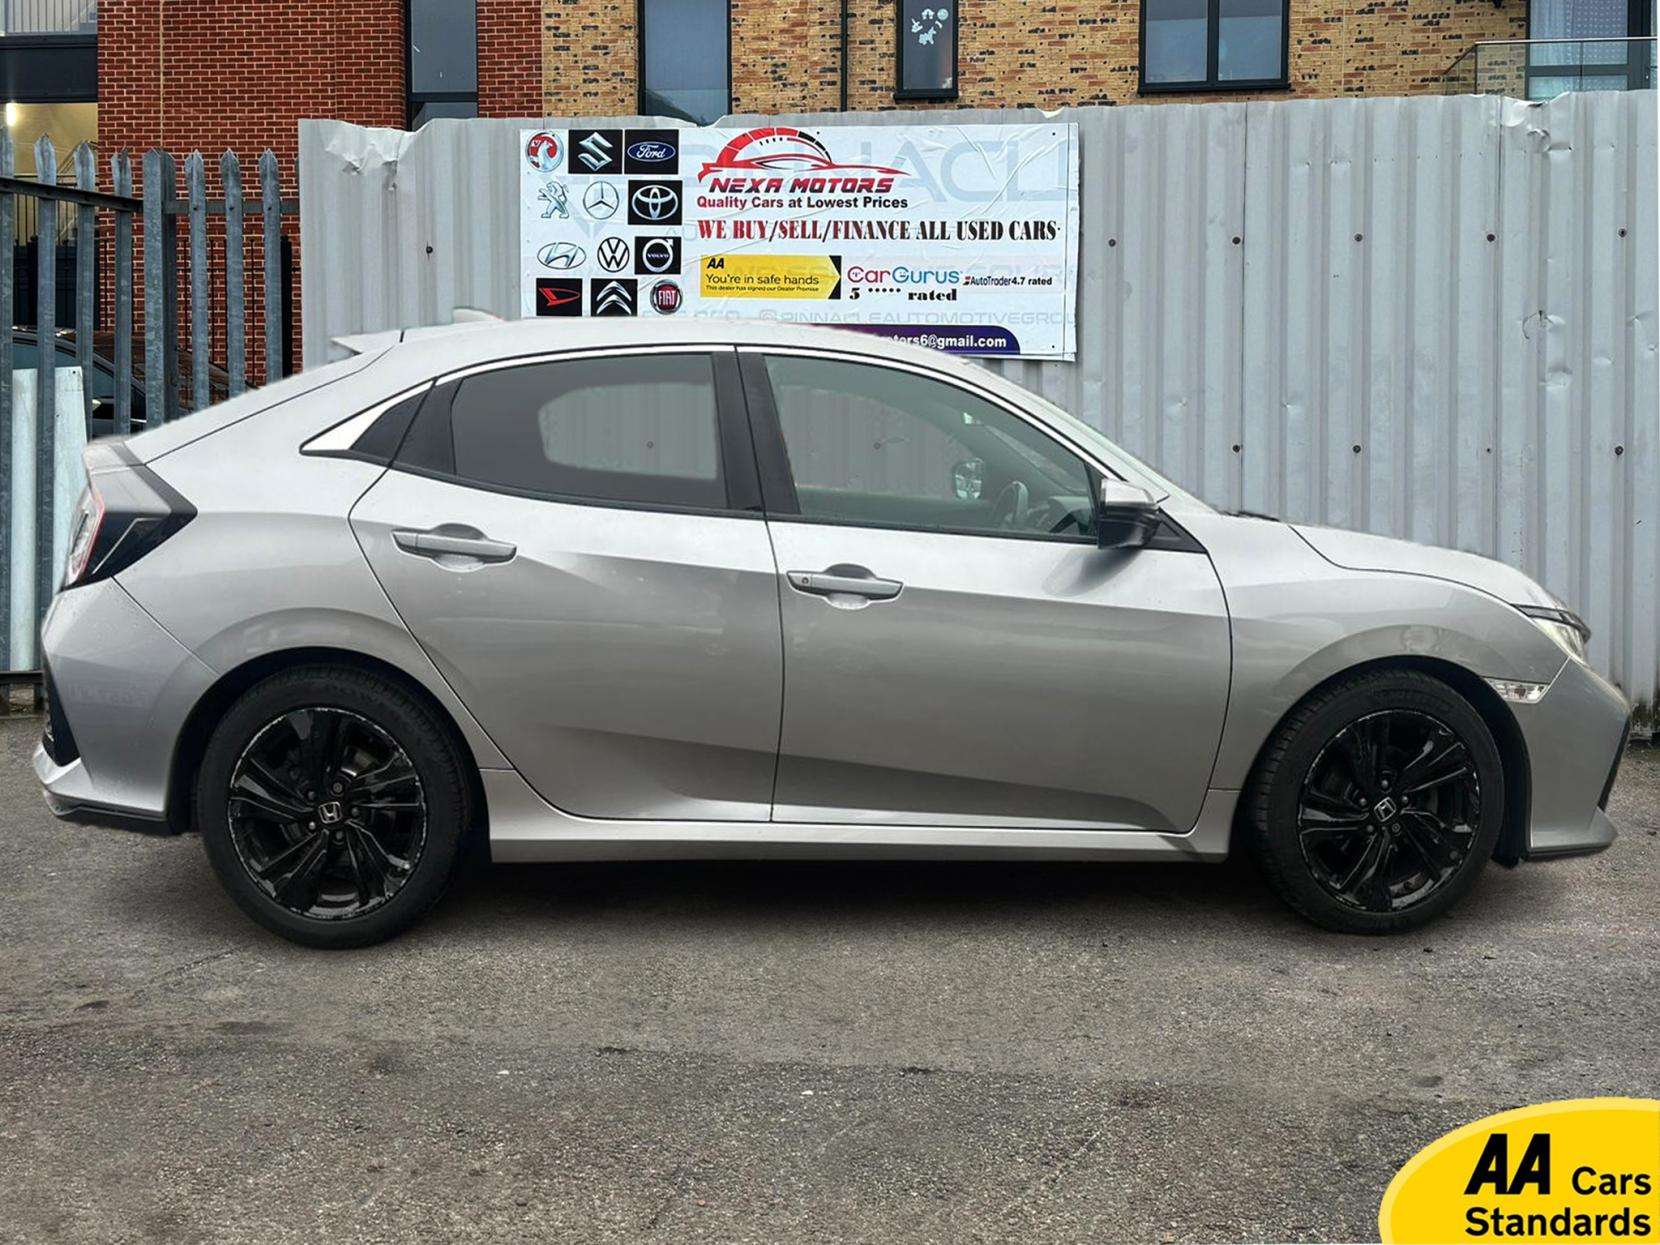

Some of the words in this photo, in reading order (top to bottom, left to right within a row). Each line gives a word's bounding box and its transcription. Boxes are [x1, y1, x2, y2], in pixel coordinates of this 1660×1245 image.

[636, 144, 666, 158] Ford
[709, 178, 784, 194] NEXA
[789, 178, 895, 194] MOTORS
[697, 196, 747, 211] Quality
[752, 196, 784, 209] Cars
[788, 197, 803, 209] at
[807, 196, 859, 209] Lowest
[863, 196, 909, 209] Prices
[697, 220, 727, 240] WE
[916, 220, 951, 240] ALL
[956, 220, 1004, 241] USED
[1008, 219, 1057, 241] CARS
[706, 257, 725, 269] AA
[706, 273, 741, 285] You're
[744, 274, 754, 284] in
[757, 274, 781, 285] safe
[784, 274, 820, 286] hands
[847, 266, 960, 284] CarGurus
[1028, 277, 1053, 286] rated
[658, 290, 676, 305] FIAT
[849, 287, 861, 301] 5
[908, 288, 958, 302] rated
